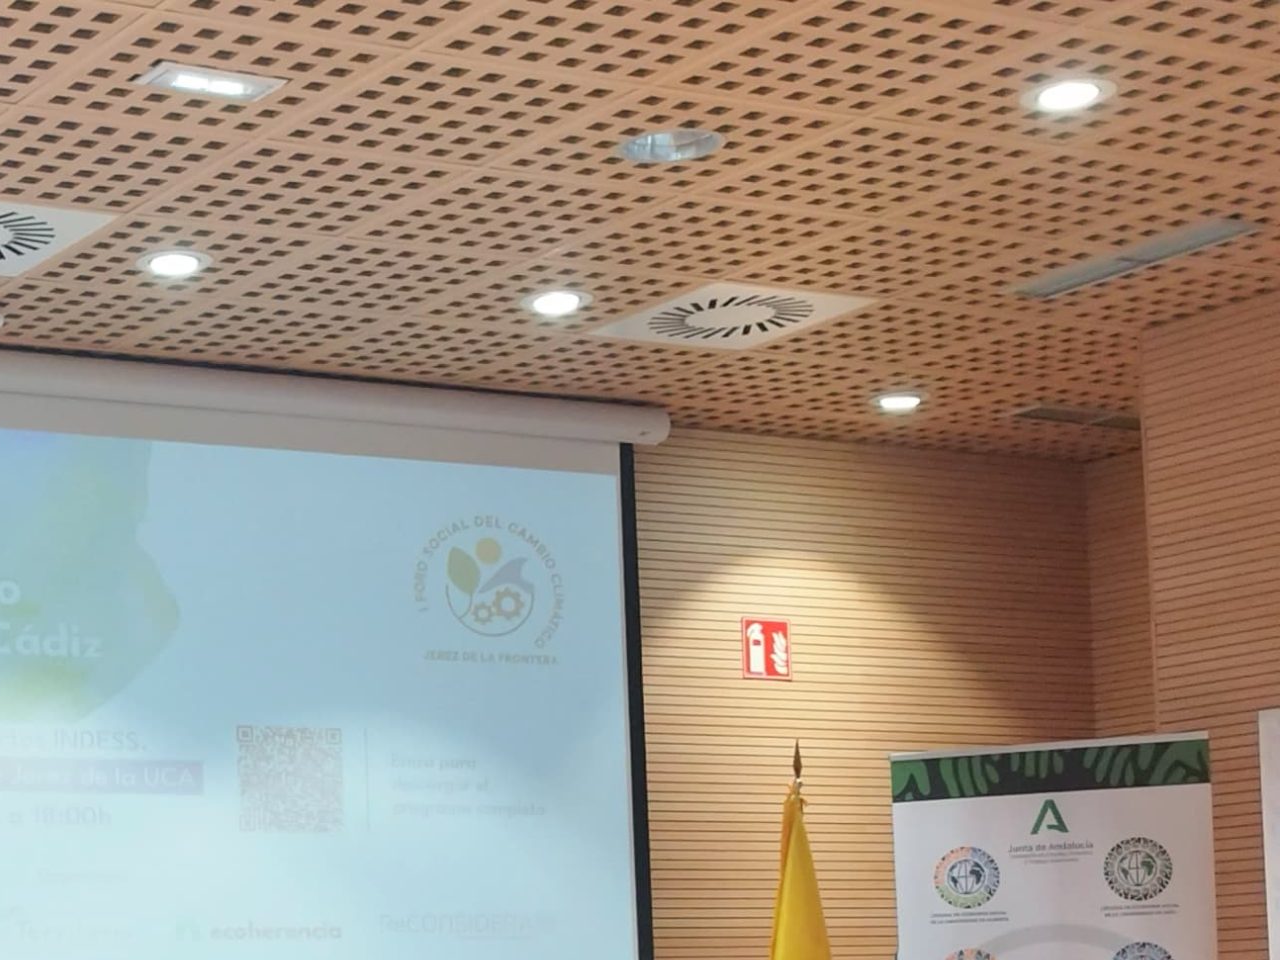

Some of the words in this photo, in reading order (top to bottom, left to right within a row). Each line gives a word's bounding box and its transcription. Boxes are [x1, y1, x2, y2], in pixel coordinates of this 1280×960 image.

[422, 519, 470, 558] SOCIAL
[473, 514, 503, 530] DEL
[507, 521, 557, 571] CAMBIO
[462, 651, 478, 663] DE
[480, 652, 496, 663] LA
[498, 652, 560, 666] FRONTERA
[143, 767, 196, 787] UCA
[1035, 843, 1046, 852] de
